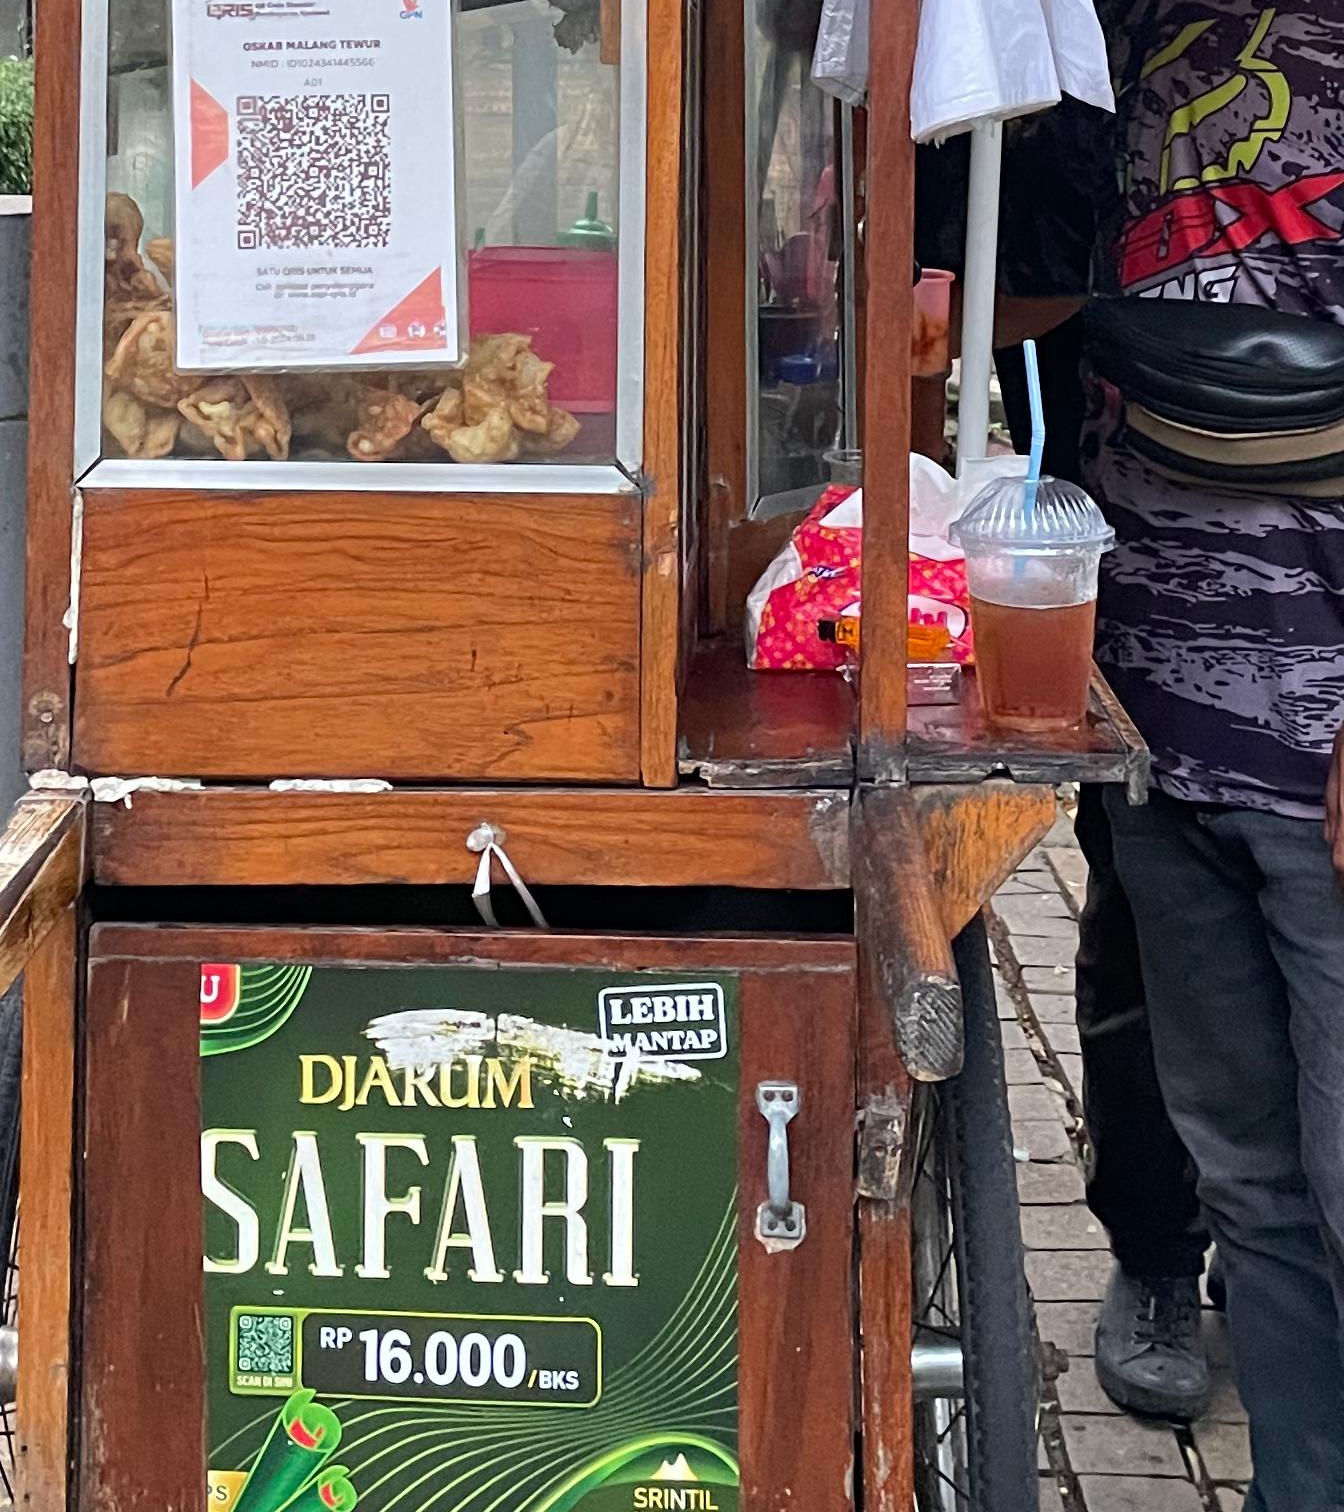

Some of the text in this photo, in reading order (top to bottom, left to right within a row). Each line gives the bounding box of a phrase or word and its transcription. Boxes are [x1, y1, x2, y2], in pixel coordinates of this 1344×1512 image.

[286, 40, 337, 51] MALANG
[339, 39, 382, 50] TEWUR
[609, 994, 716, 1025] LEBIH
[611, 1028, 718, 1052] MANTAP
[200, 1127, 642, 1288] SAFARI
[319, 1326, 353, 1350] RP
[633, 1487, 719, 1511] SRINTIL
